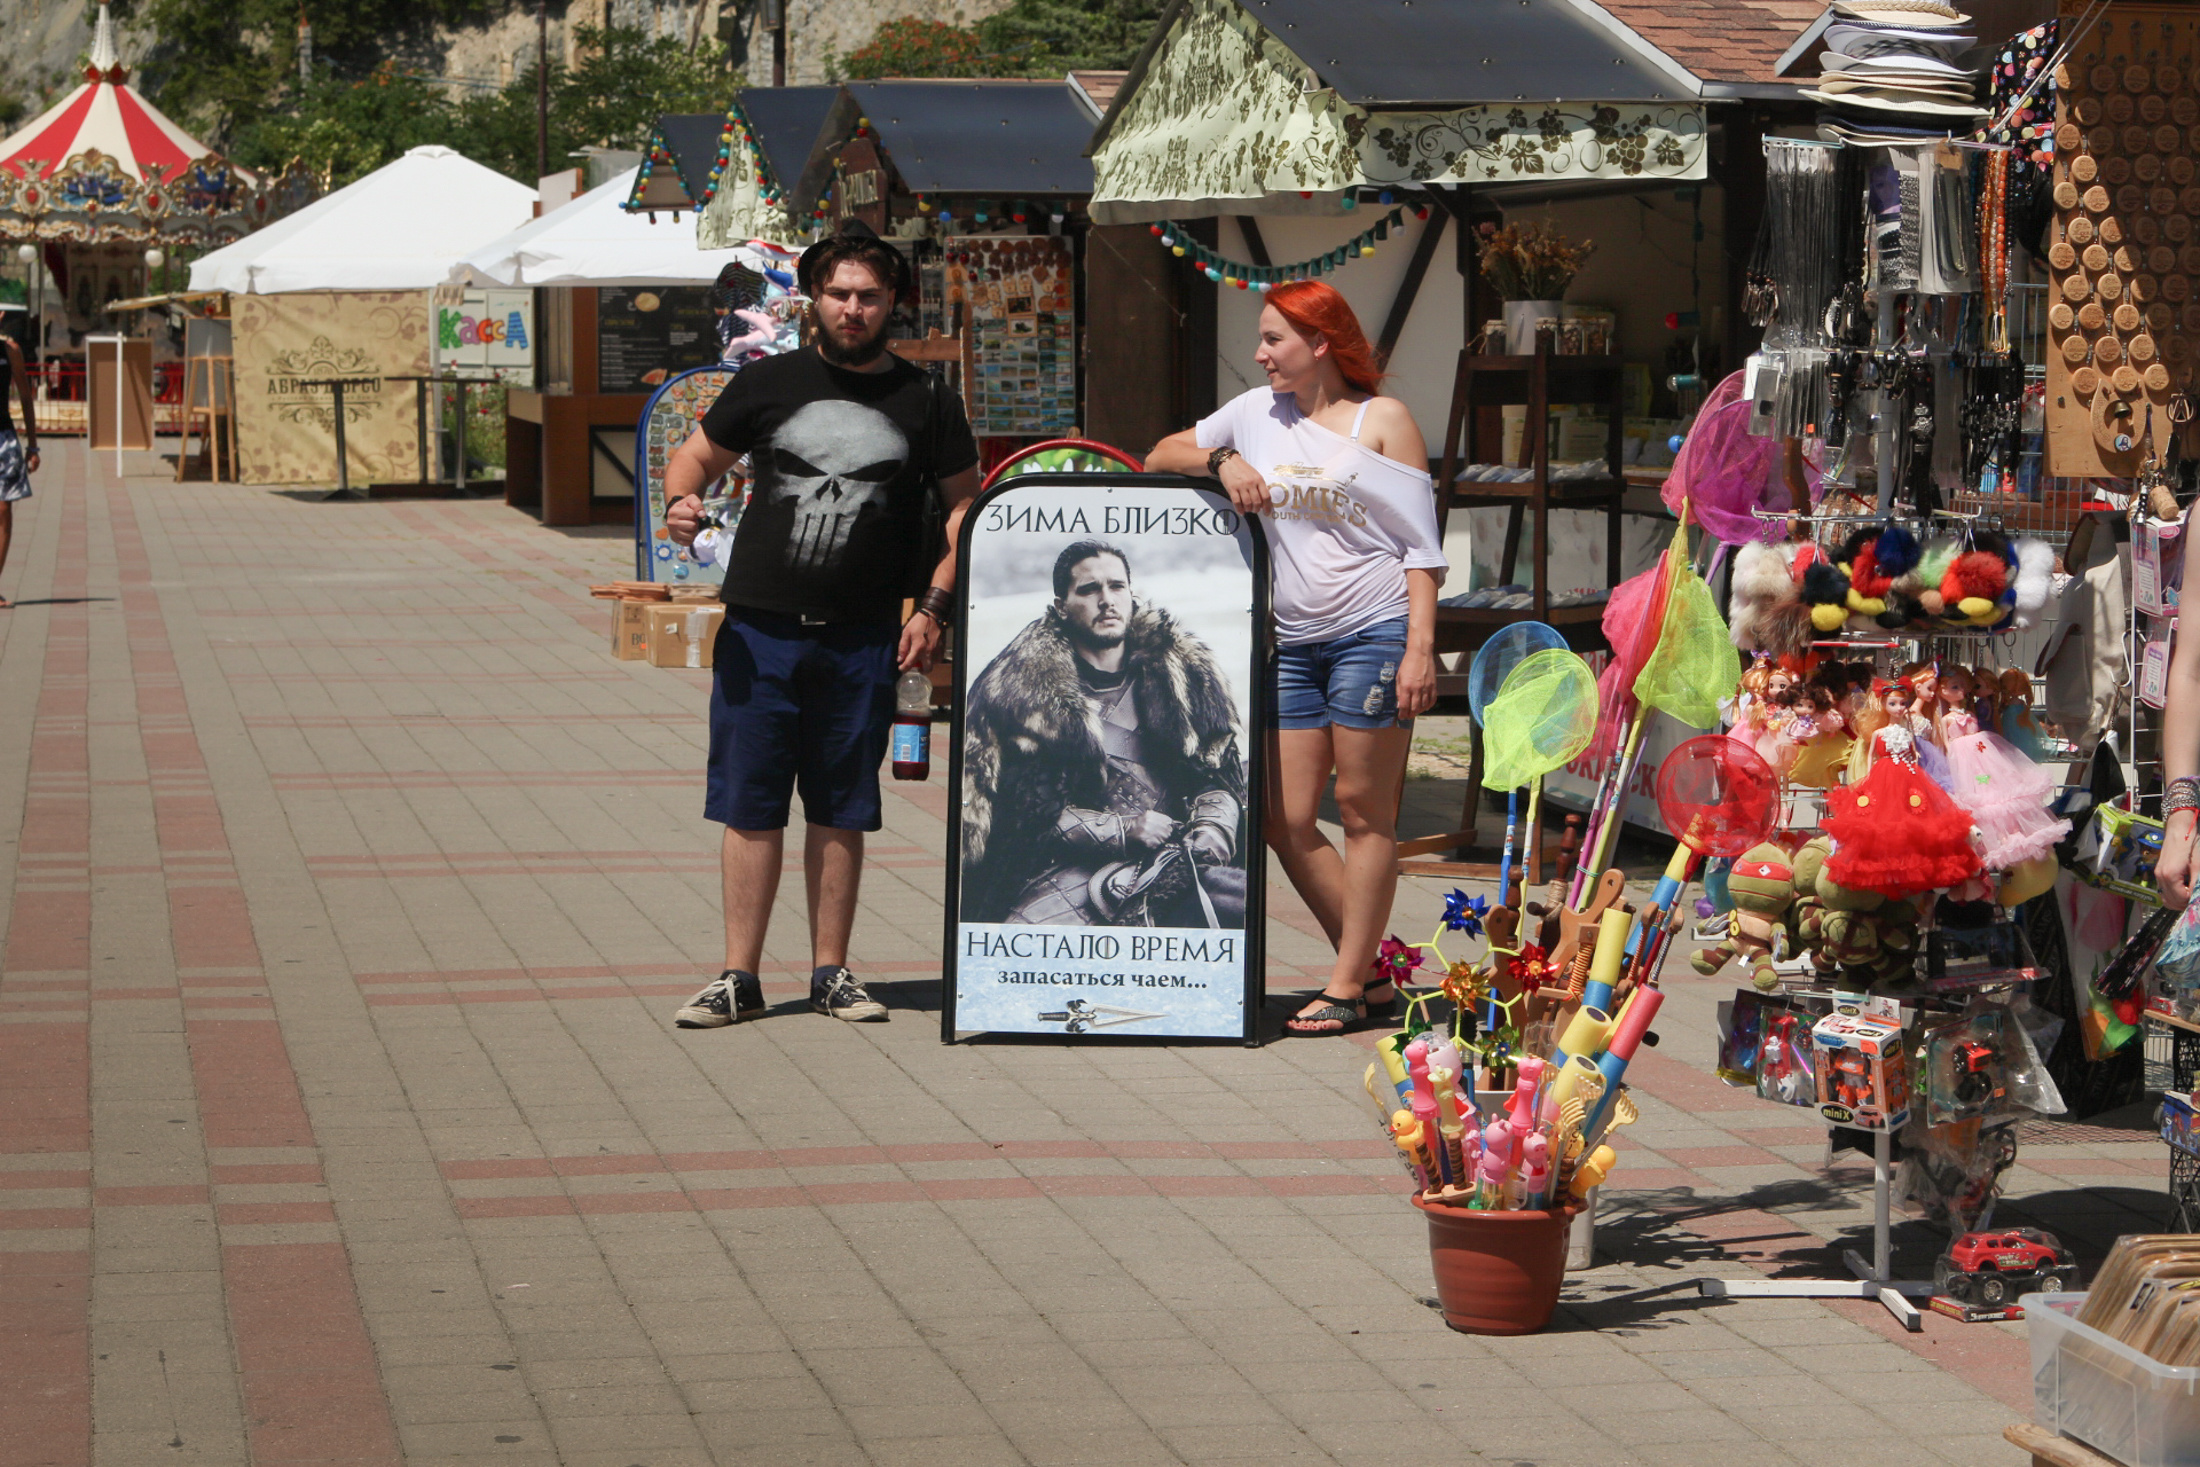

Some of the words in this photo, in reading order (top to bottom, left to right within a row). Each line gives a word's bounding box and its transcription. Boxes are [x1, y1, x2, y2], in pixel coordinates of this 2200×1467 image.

[985, 504, 1093, 534] ЗИМА
[1102, 506, 1241, 536] БЛИЗКО
[966, 931, 1120, 960] НАСТАЛО
[1130, 935, 1235, 963] ВРЕМЯ
[997, 970, 1126, 987] запасаться
[1131, 973, 1208, 989] чаем...
